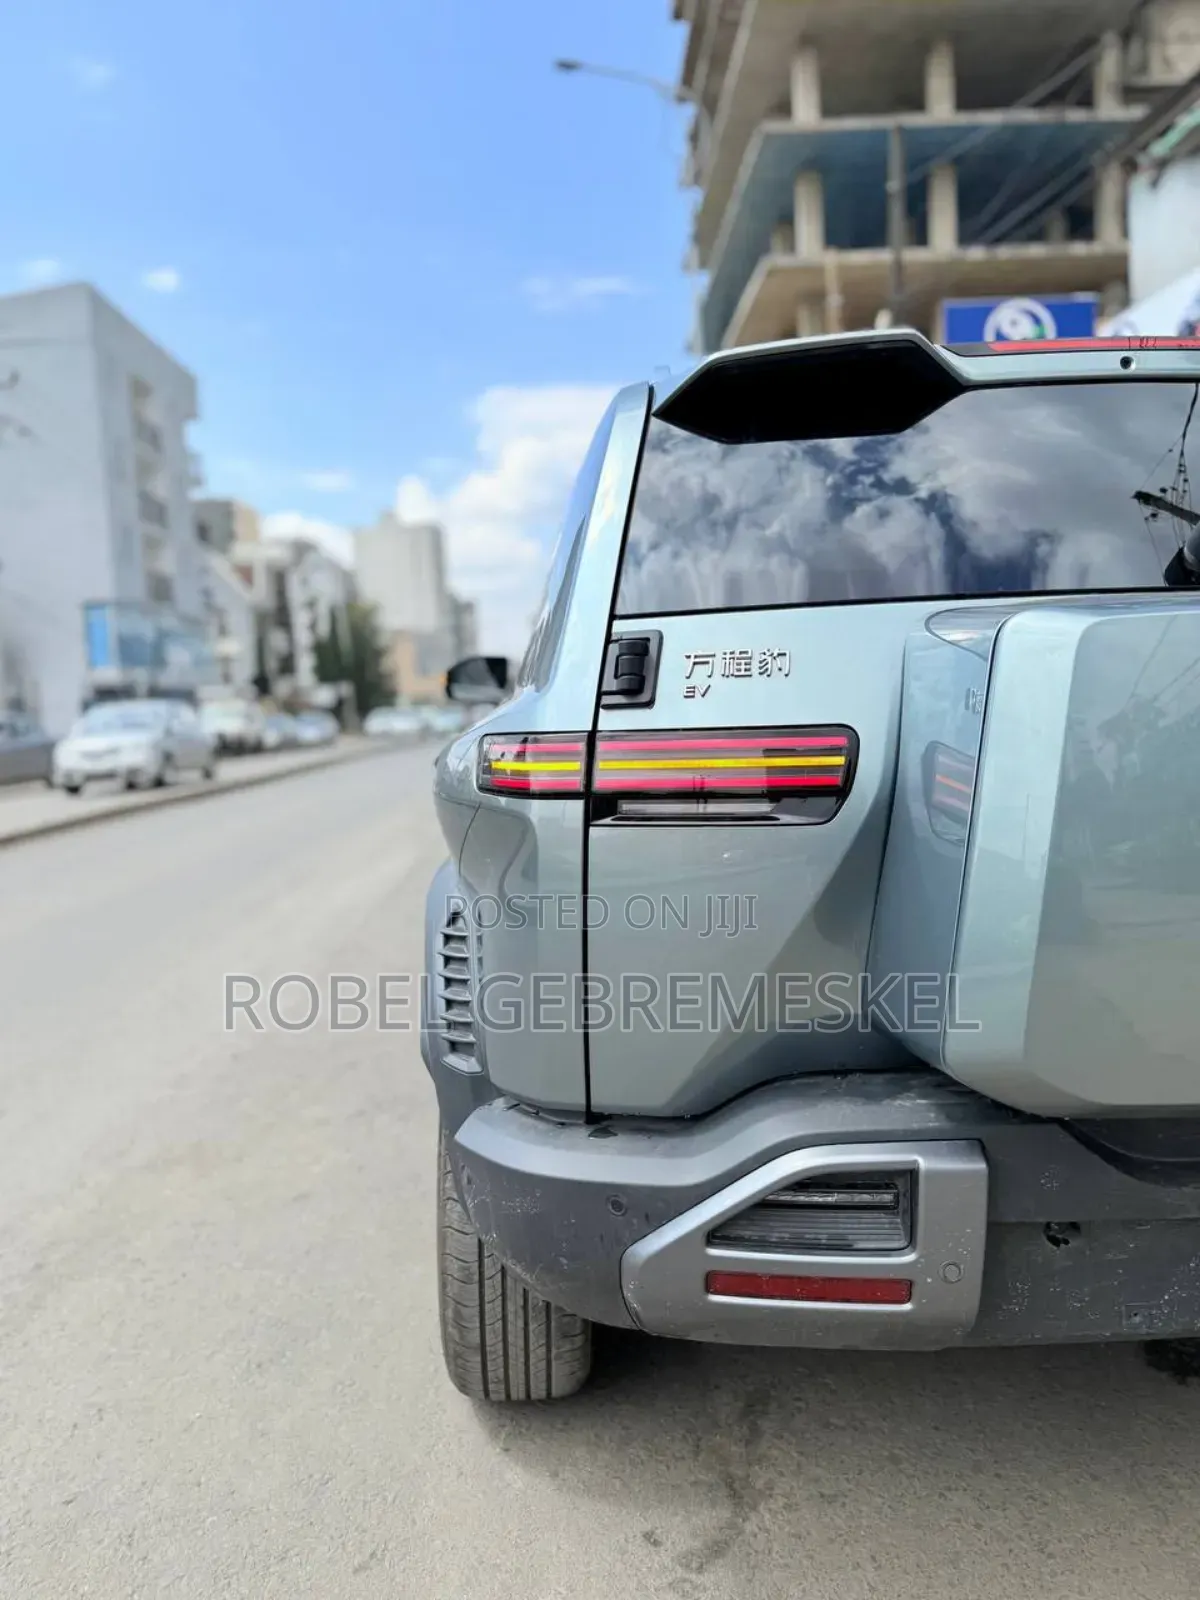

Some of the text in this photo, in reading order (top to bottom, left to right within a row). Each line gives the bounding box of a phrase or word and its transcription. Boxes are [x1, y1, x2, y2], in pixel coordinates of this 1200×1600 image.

[684, 648, 791, 679] 方程豹
[683, 684, 711, 699] EV
